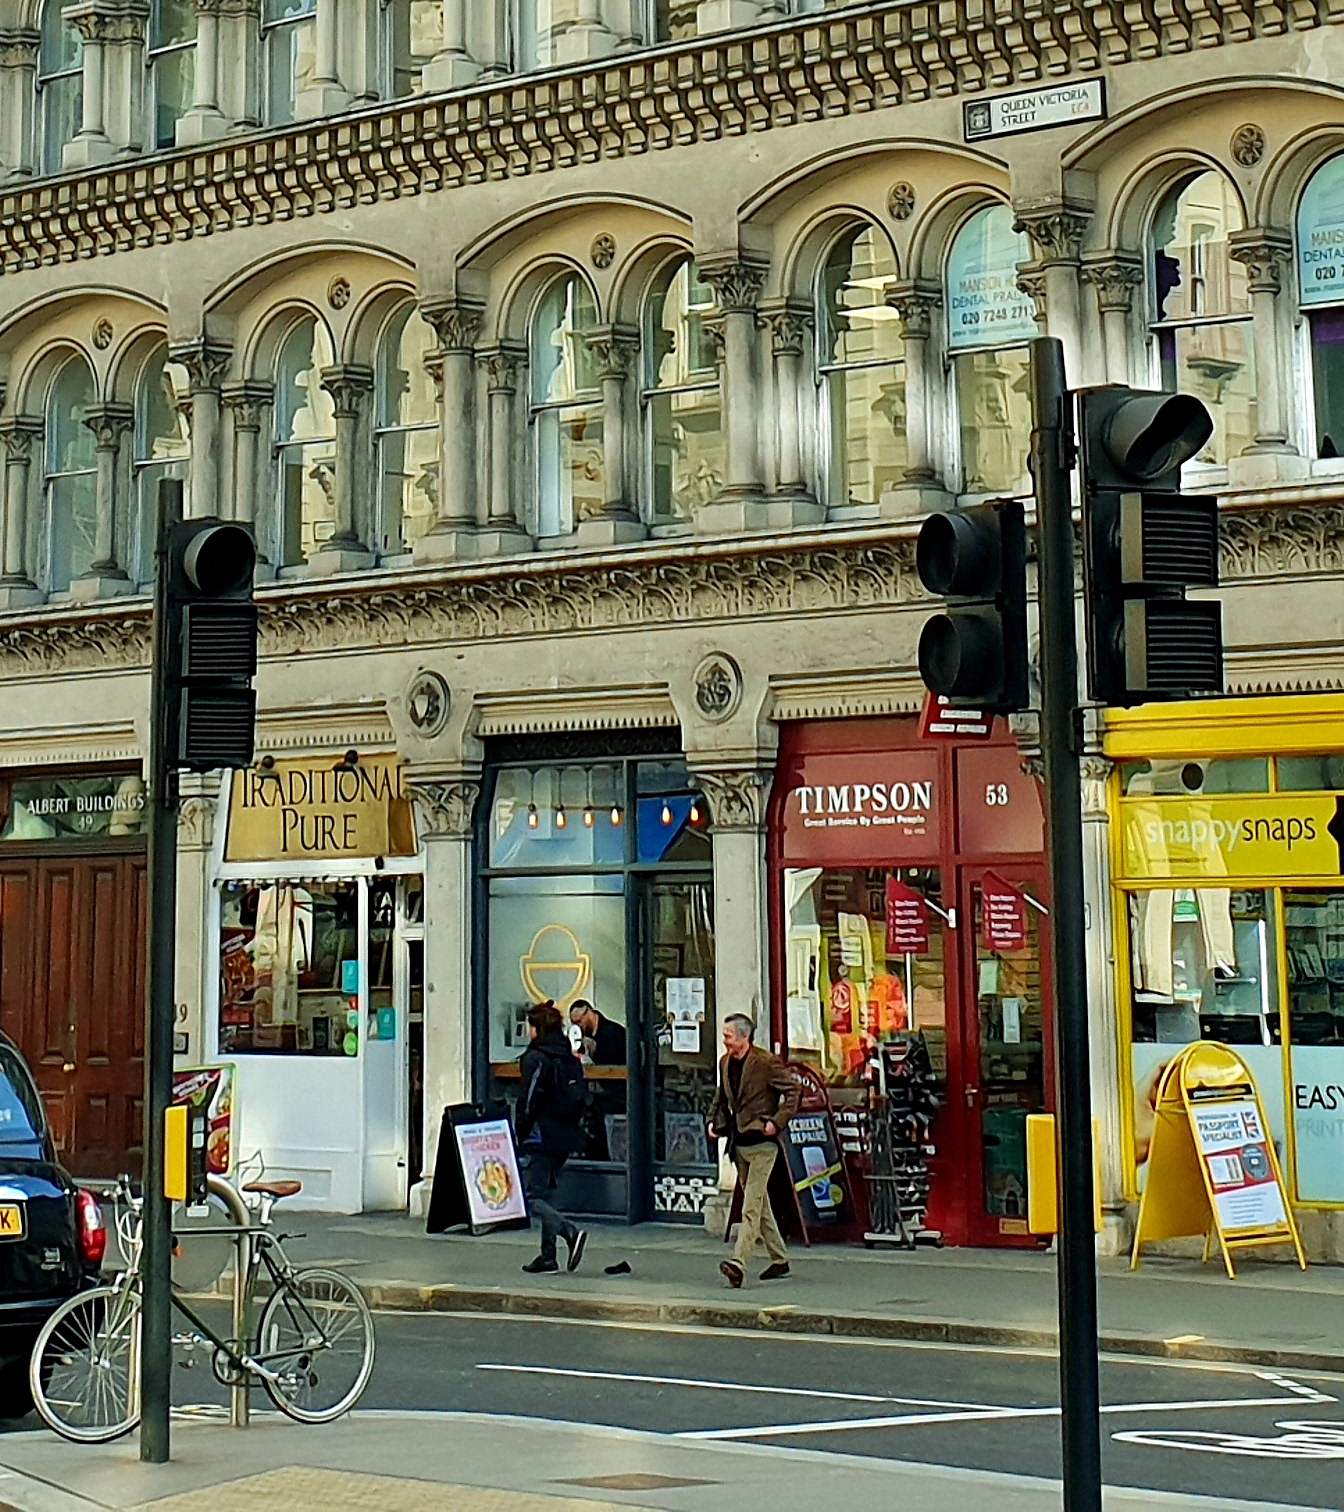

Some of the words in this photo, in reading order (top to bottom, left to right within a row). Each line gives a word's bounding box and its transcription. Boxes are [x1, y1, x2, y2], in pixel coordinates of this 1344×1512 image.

[1001, 96, 1036, 113] QUEEN
[1038, 88, 1089, 107] VICTORIA
[1001, 111, 1037, 126] STREET
[1315, 266, 1336, 280] 020
[961, 312, 980, 324] 020
[27, 797, 70, 815] ALBERT
[77, 793, 145, 813] BUILDINGS
[795, 781, 933, 815] TIMPSON
[986, 784, 1009, 806] 53
[281, 808, 358, 852] PURE
